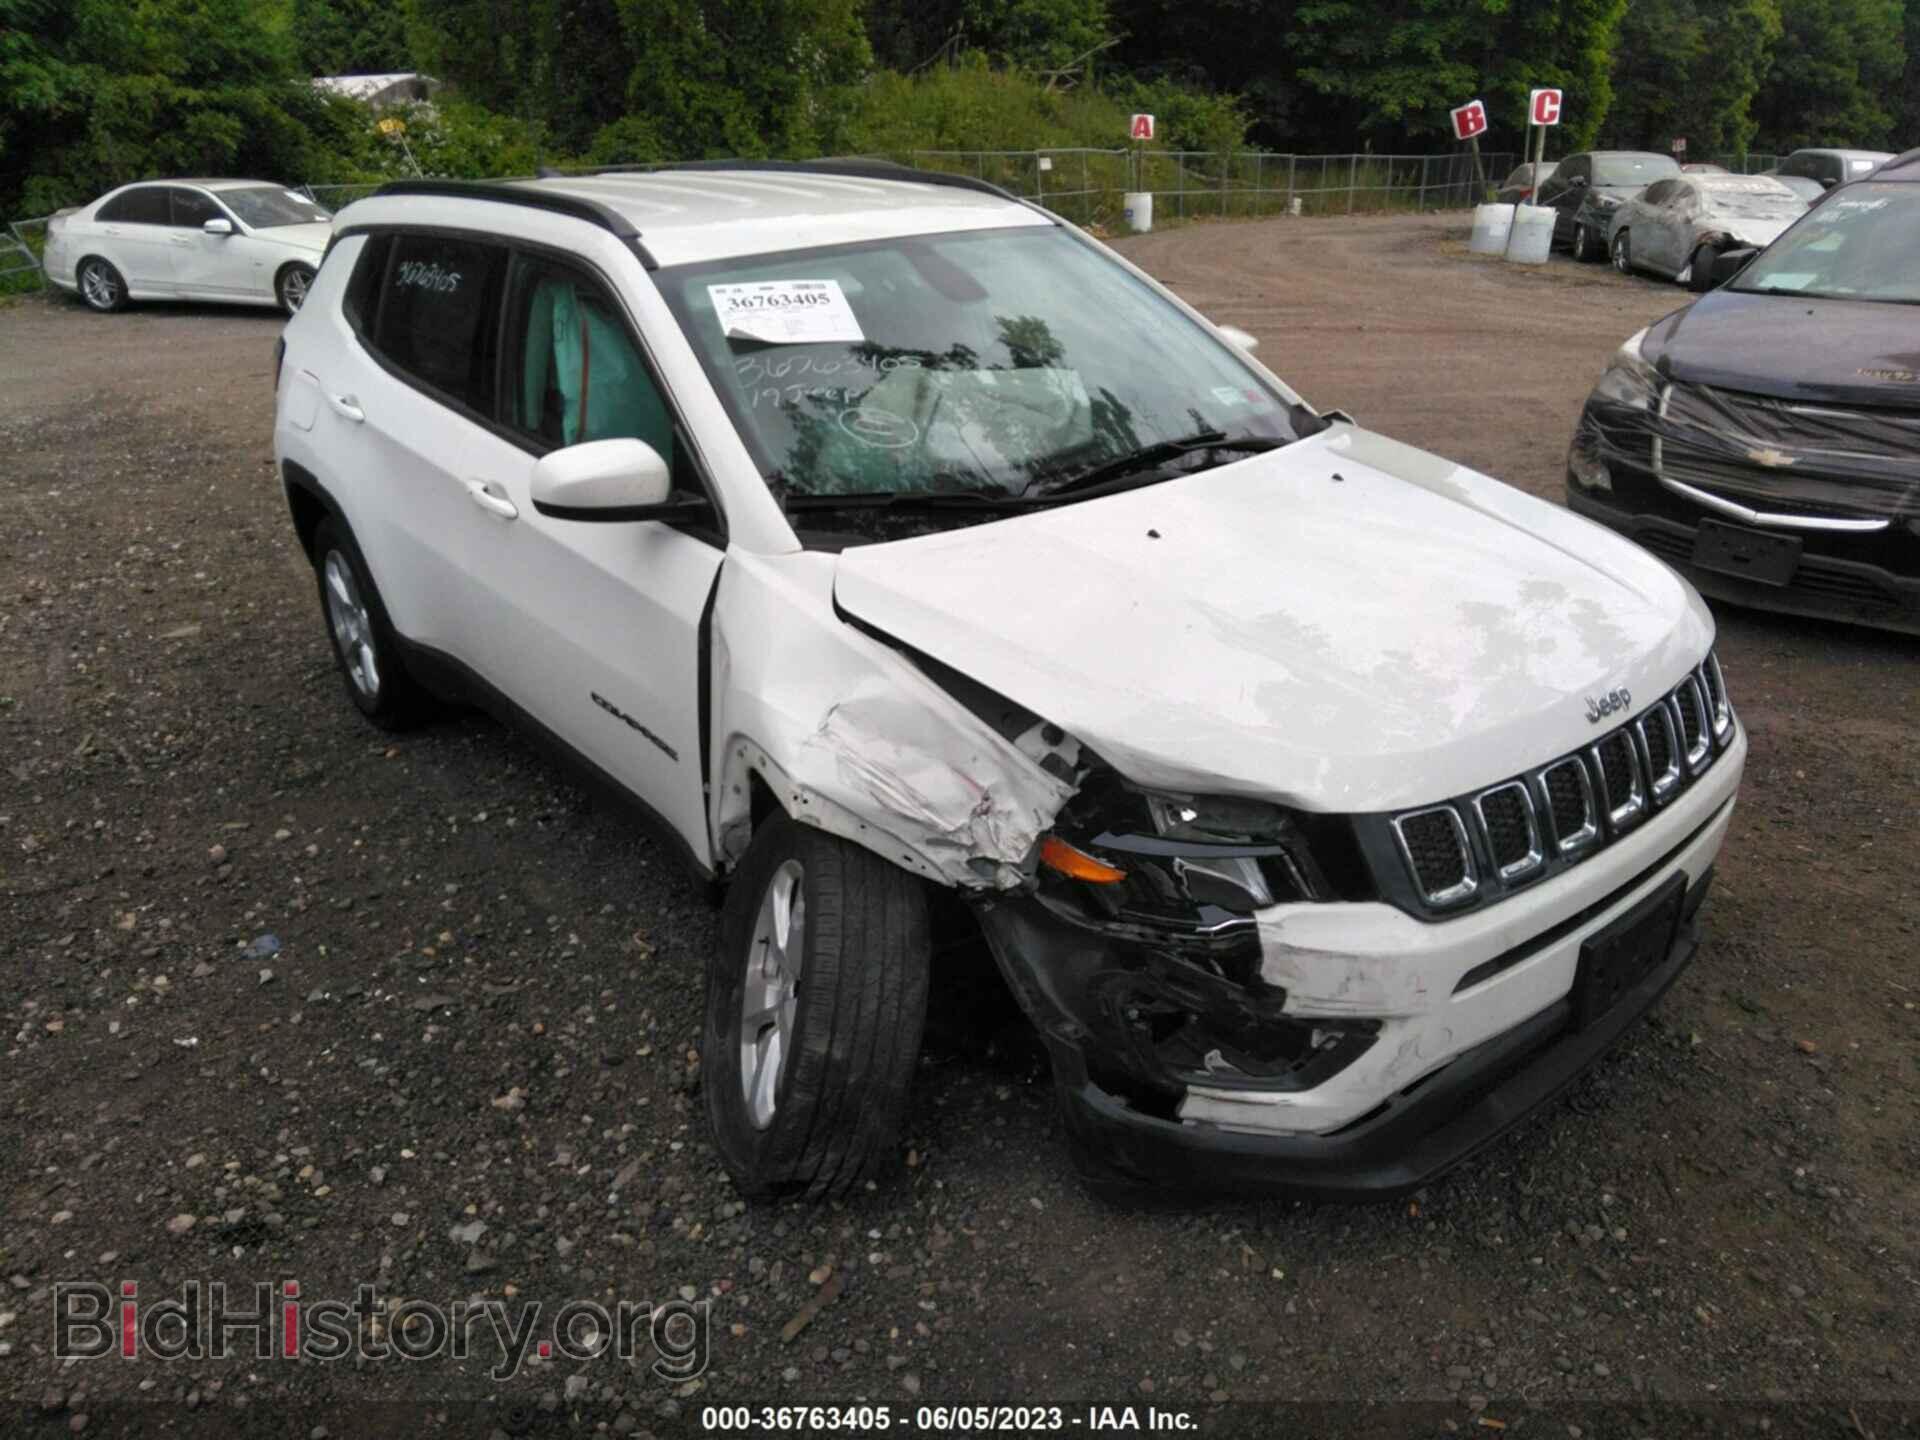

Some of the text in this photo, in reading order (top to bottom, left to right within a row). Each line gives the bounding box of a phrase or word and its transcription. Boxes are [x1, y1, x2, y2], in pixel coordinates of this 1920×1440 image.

[1455, 105, 1485, 137] B
[1535, 91, 1560, 123] C
[1132, 115, 1153, 137] A
[727, 292, 831, 311] 36763405
[1584, 689, 1632, 724] Jeep
